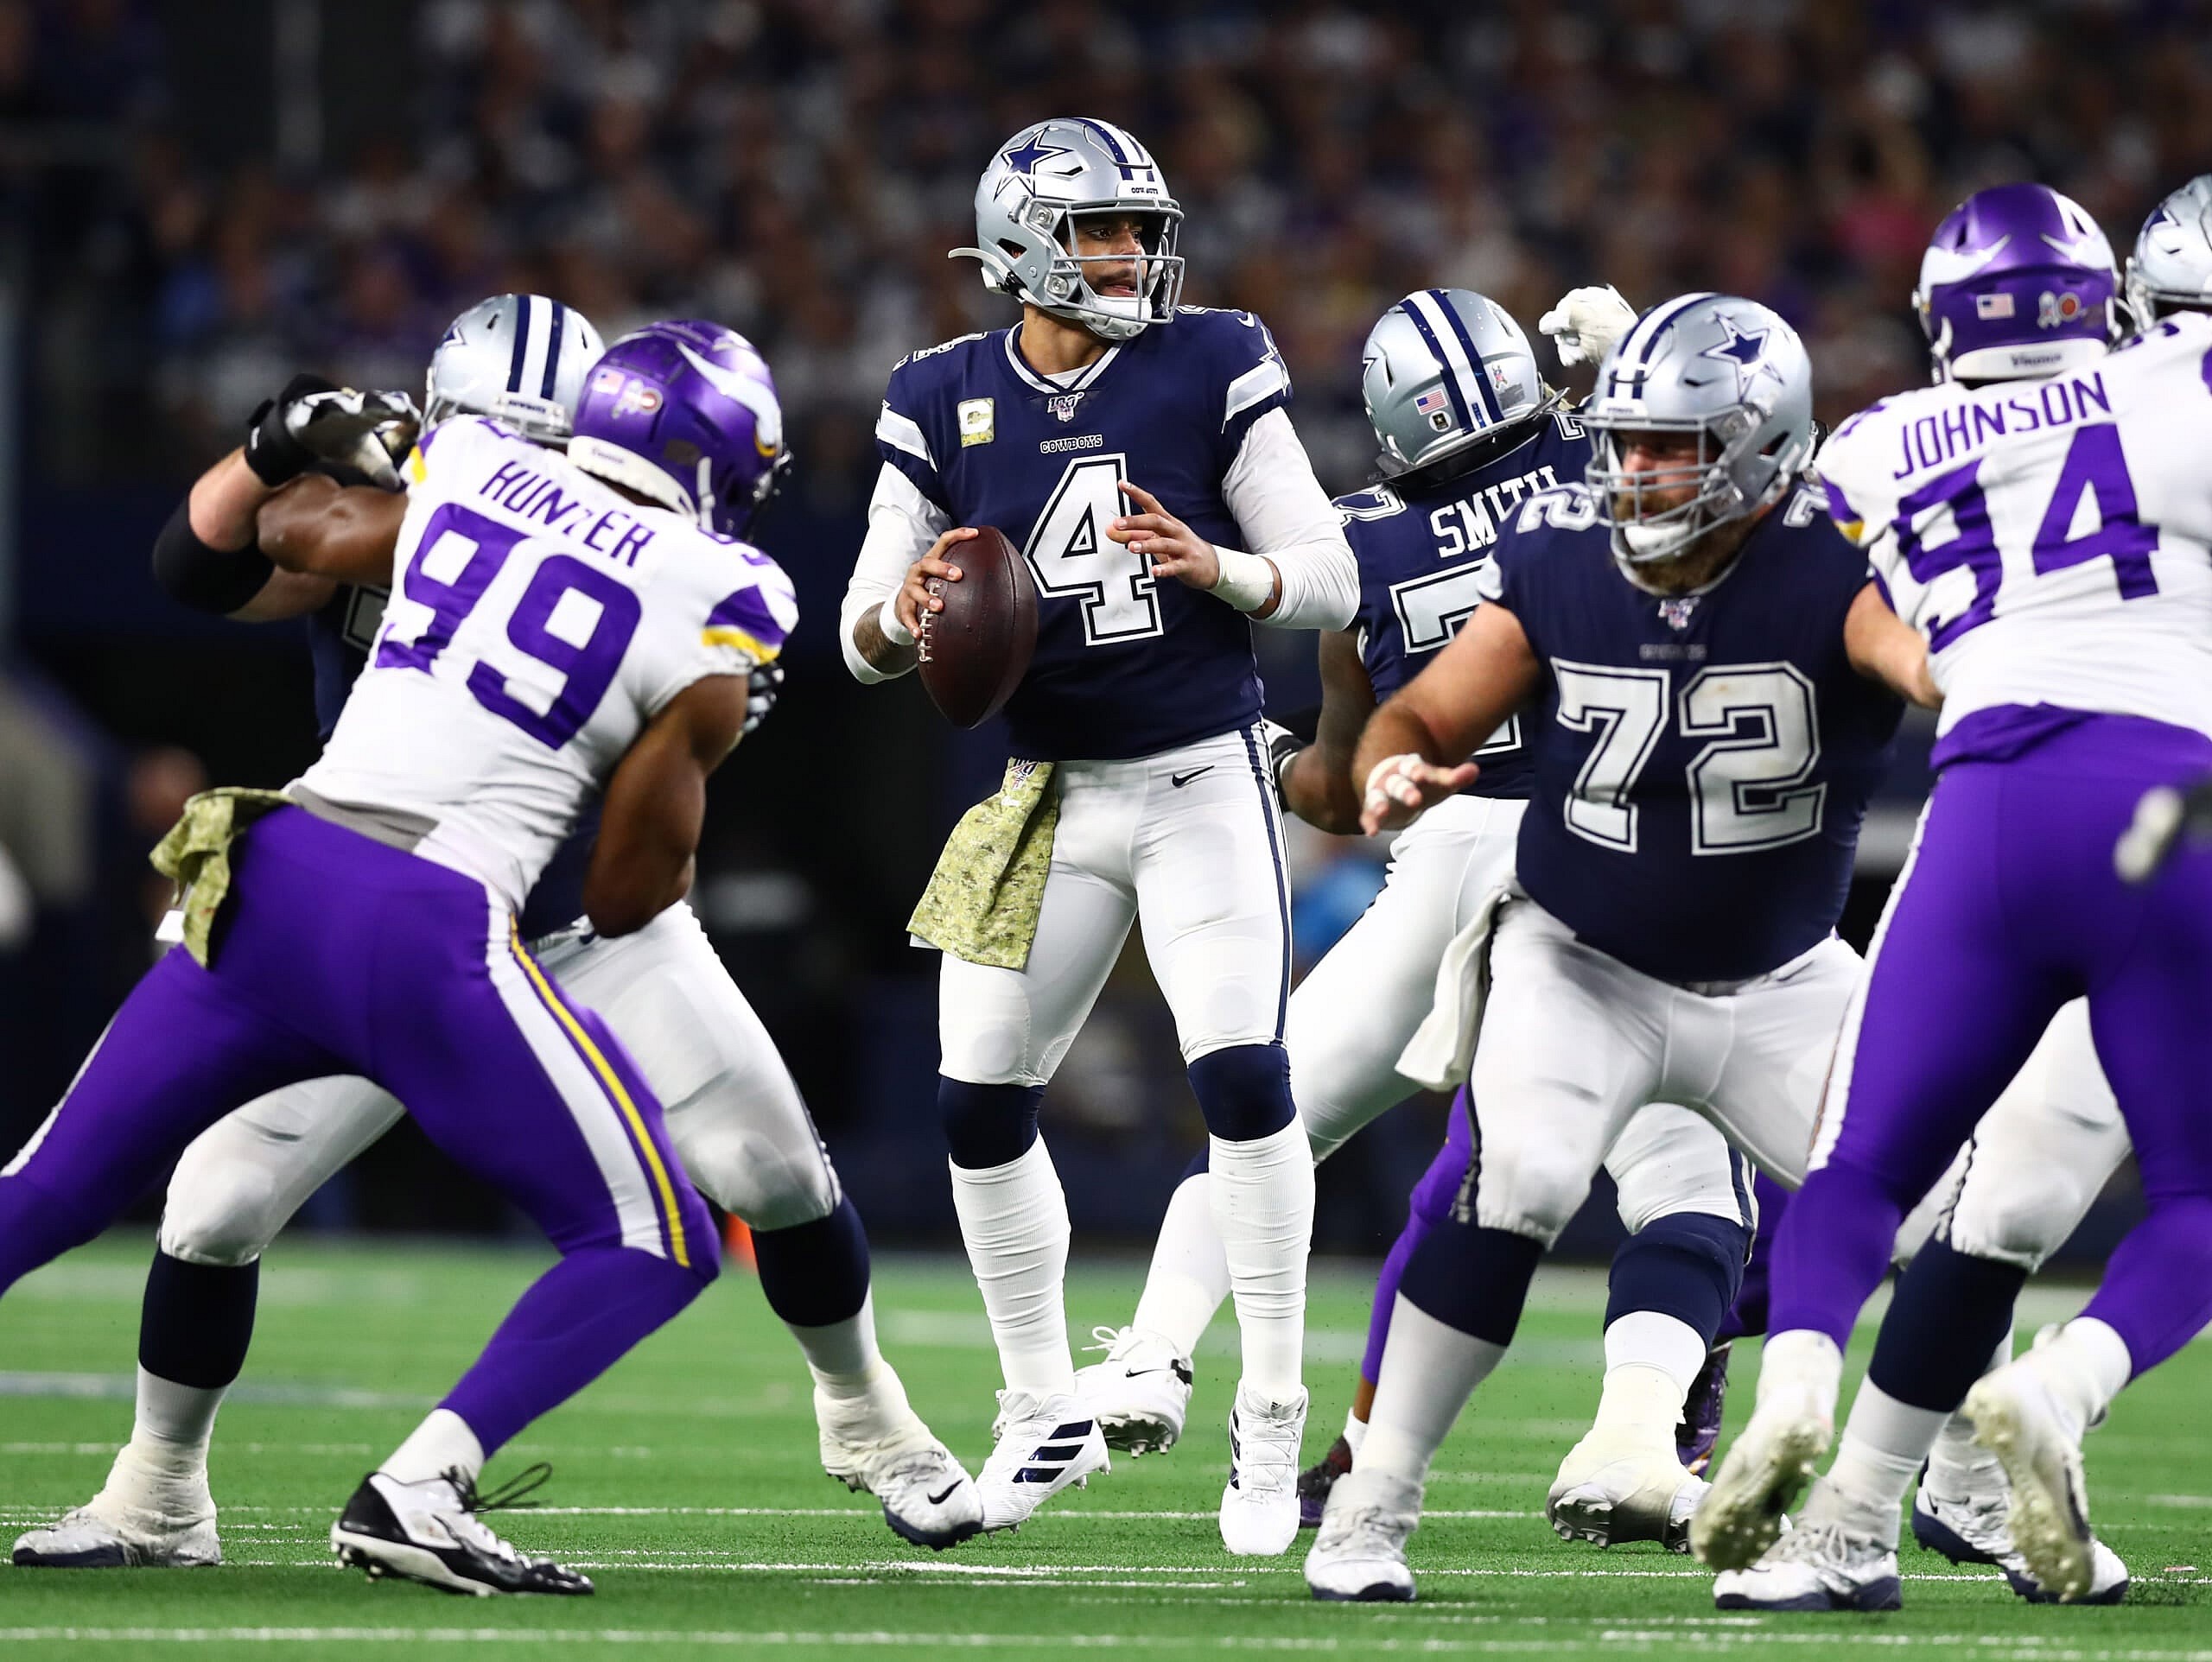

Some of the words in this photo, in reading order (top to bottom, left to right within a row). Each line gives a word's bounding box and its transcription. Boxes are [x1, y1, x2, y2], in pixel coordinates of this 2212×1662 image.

[480, 460, 656, 568] HUNTER
[1040, 435, 1103, 454] COWBOYS
[1893, 371, 2112, 480] JOHNSON
[374, 502, 642, 751] 99
[1022, 452, 1164, 646] 4
[1890, 421, 2160, 655] 94
[1550, 657, 1827, 856] 72
